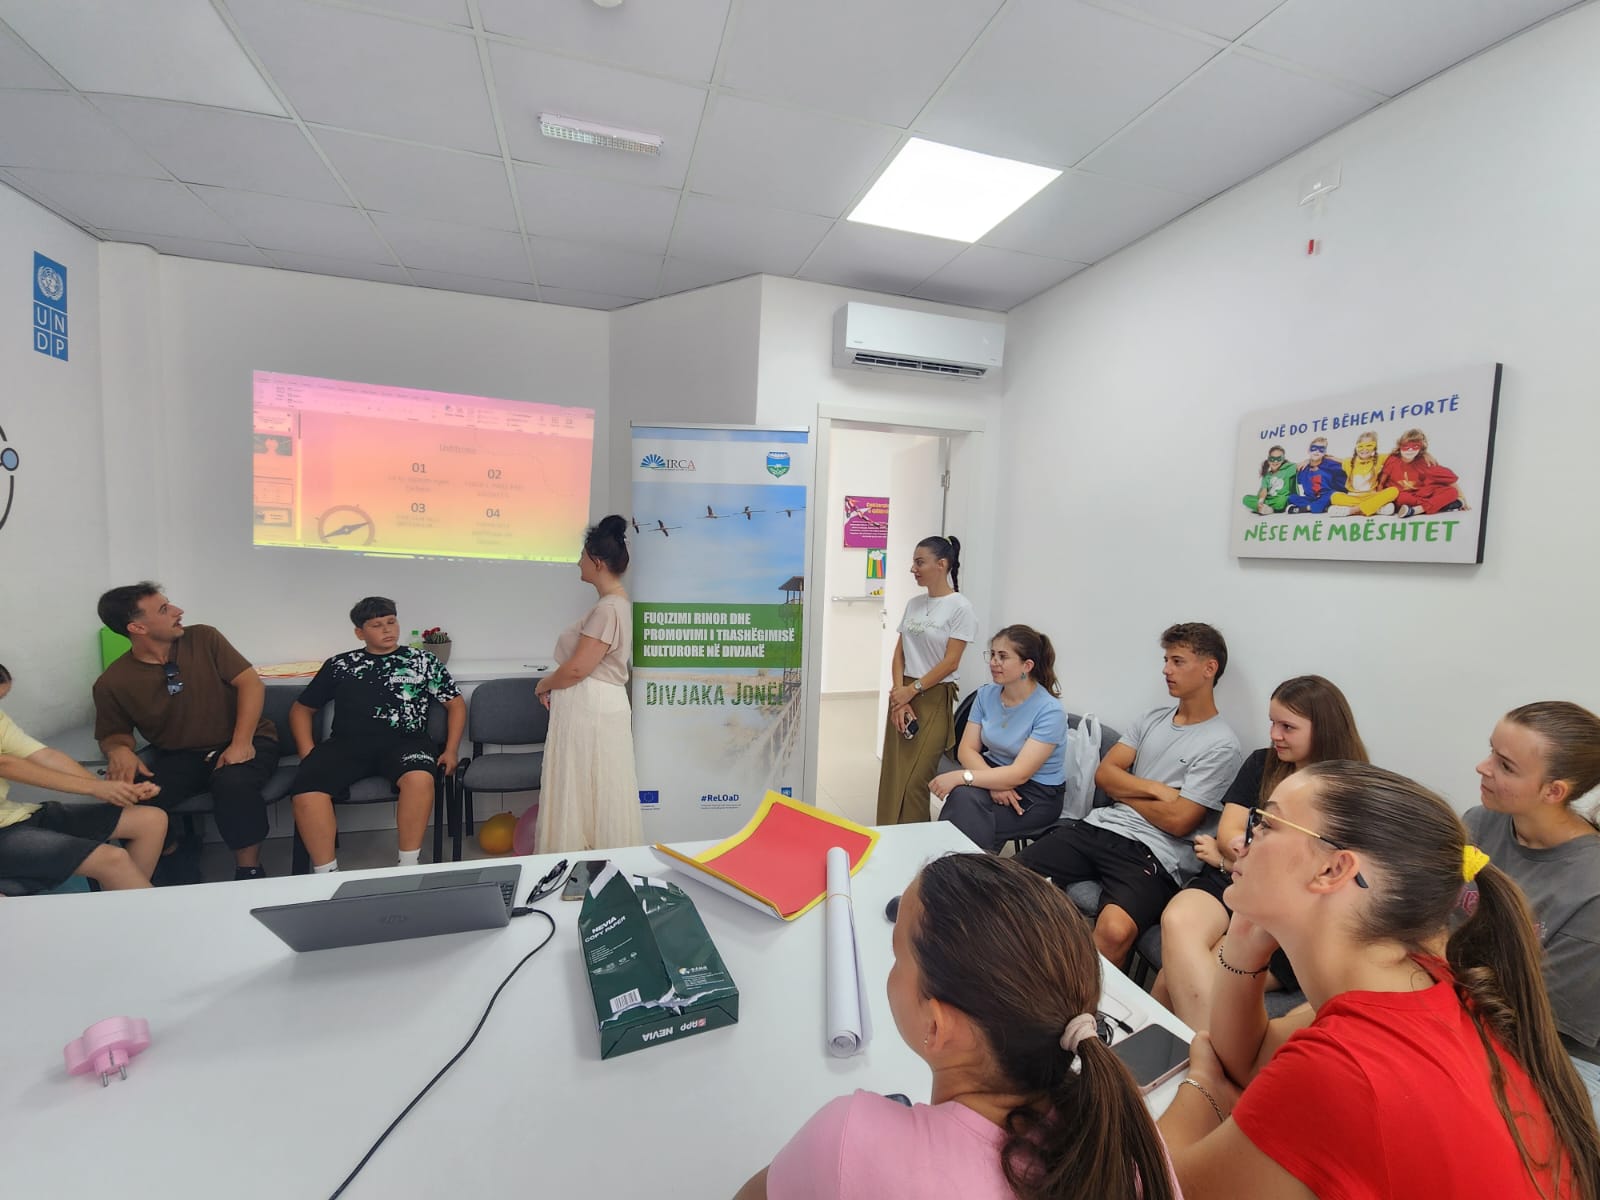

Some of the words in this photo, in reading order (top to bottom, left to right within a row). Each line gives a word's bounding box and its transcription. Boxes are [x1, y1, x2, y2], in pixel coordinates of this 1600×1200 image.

[1260, 424, 1286, 440] UNË
[1289, 423, 1308, 436] DO
[1312, 416, 1329, 433] TË
[1332, 411, 1385, 430] BËHEM
[1400, 394, 1460, 419] FORTË
[411, 462, 427, 474] 01
[667, 459, 696, 470] IRCA
[487, 468, 502, 480] 02
[410, 502, 426, 513] 03
[485, 508, 501, 519] 04
[1244, 521, 1289, 542] NËSE
[1292, 520, 1323, 542] MË
[1327, 518, 1460, 543] MBËSHTET
[643, 611, 692, 626] FUQIZIMI
[693, 612, 728, 625] RINOR
[729, 612, 751, 625] DHE
[643, 628, 708, 641] PROMOVIMI
[709, 628, 715, 641] I
[716, 627, 795, 642] TRASHËGIMISË
[643, 644, 705, 657] KULTURORE
[706, 643, 720, 658] NË
[722, 643, 765, 658] DIVJAKË
[701, 794, 740, 802] #ReLOaD
[584, 930, 604, 943] COPY
[605, 916, 626, 932] PAPER
[592, 917, 617, 934] NEVIA
[641, 1026, 674, 1042] NEVIA
